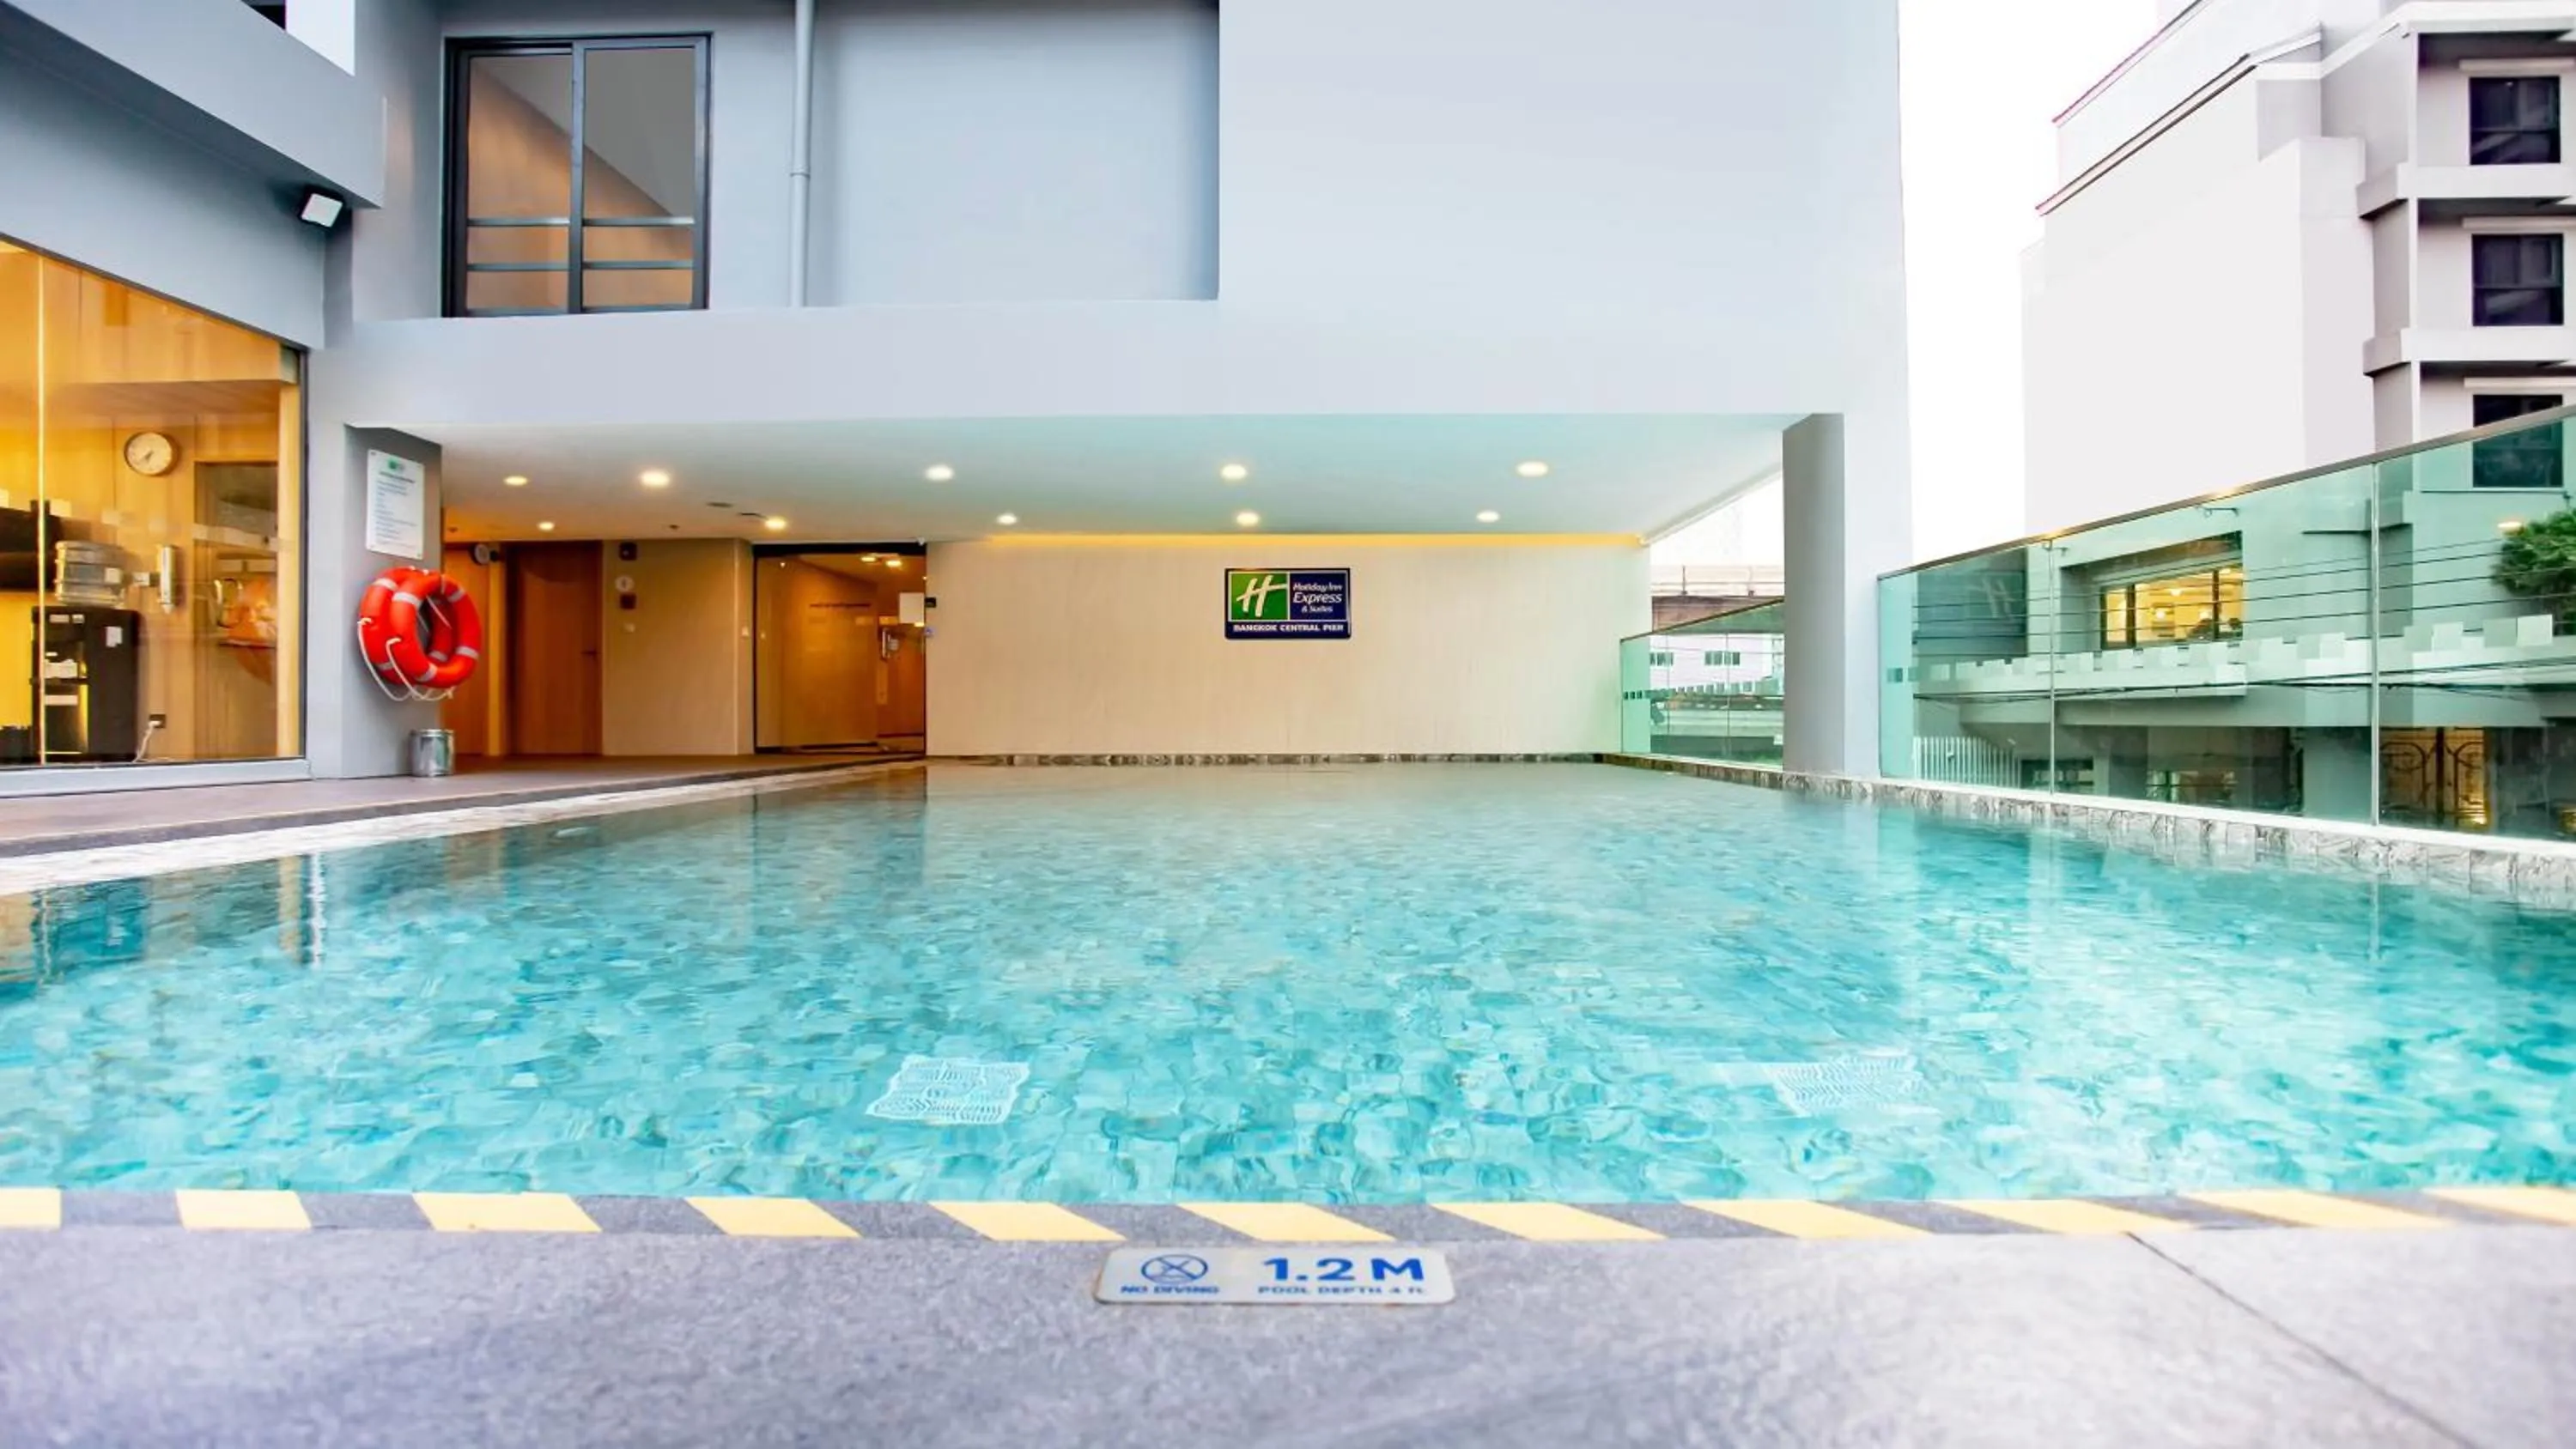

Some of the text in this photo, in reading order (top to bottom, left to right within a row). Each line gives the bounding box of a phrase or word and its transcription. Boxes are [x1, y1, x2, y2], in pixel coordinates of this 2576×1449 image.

[1292, 582, 1342, 592] Holiday Inn
[1292, 591, 1342, 604] Express
[1233, 623, 1344, 632] BANGKOK CENTRAL PIER
[1263, 1258, 1424, 1281] 1.2 M
[1258, 1286, 1309, 1294] POOL
[1318, 1286, 1382, 1294] DEPTH
[1388, 1286, 1401, 1294] 4
